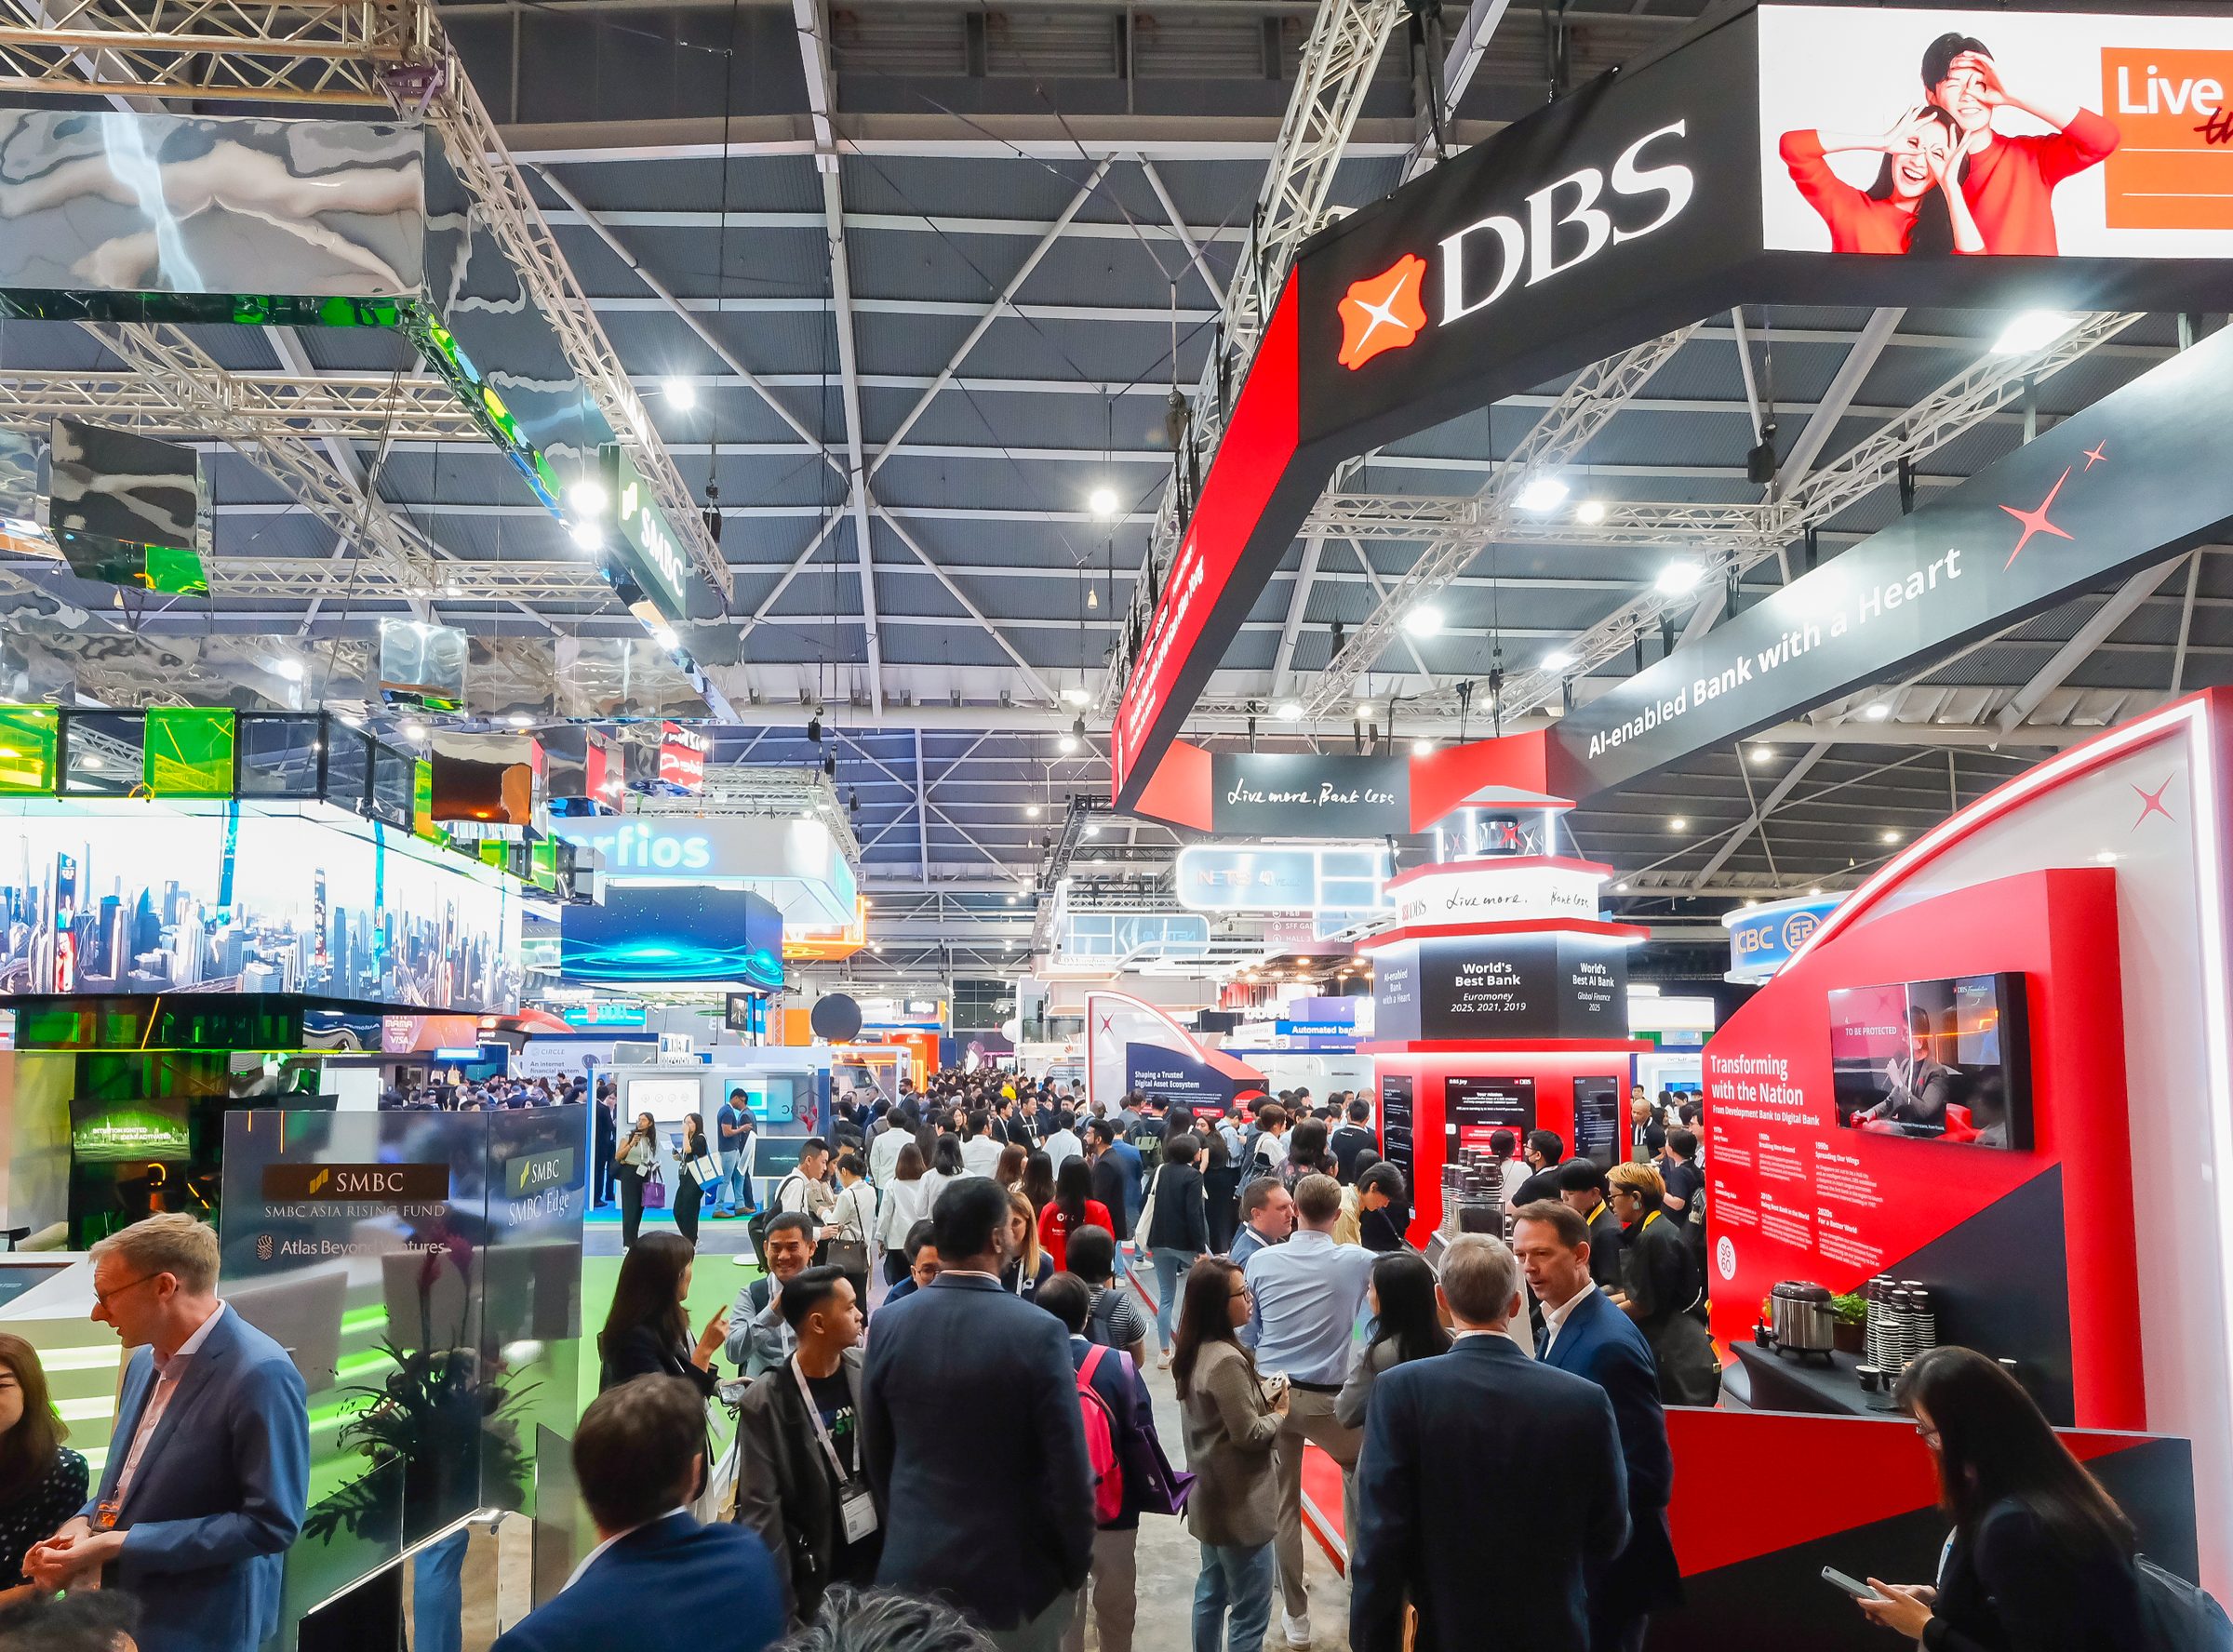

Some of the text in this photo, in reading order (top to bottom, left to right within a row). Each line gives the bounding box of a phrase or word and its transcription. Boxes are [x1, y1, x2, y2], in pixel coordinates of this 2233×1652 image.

[2118, 64, 2224, 115] Live
[1437, 118, 1694, 327] DBS
[640, 507, 684, 598] SMBC
[1588, 548, 1962, 760] AI-enabled Bank with a Heart
[1227, 778, 1266, 805] Live
[1319, 782, 1359, 806] Bank
[1365, 789, 1395, 805] less
[1197, 871, 1250, 886] NETS
[1446, 886, 1480, 910] Live
[1550, 886, 1571, 905] Bank
[1409, 899, 1427, 919] DBS
[1286, 935, 1305, 943] HALL
[1734, 926, 1774, 954] ICBC
[1462, 963, 1512, 974] World's
[1580, 963, 1606, 975] World's
[1389, 982, 1402, 993] Bank
[1455, 975, 1521, 987] Best Bank
[1572, 975, 1615, 988] Best AI Bank
[1383, 993, 1395, 1006] with
[1397, 993, 1411, 1005] Heart
[1464, 993, 1514, 1003] Euromoney
[1577, 992, 1611, 1002] Global Finance
[1451, 1002, 1527, 1013] 2025, 2021, 2019
[1588, 1004, 1601, 1012] 2025
[1291, 1026, 1337, 1034] Automated
[1854, 1027, 1863, 1035] BE
[1863, 1026, 1897, 1035] PROTECTED
[391, 1036, 408, 1045] VISA
[1711, 1054, 1788, 1081] Transforming
[1135, 1071, 1157, 1080] Shaping
[1161, 1071, 1183, 1079] Trusted
[1135, 1080, 1153, 1089] Digital
[1170, 1081, 1200, 1089] Ecosystem
[1712, 1080, 1804, 1106] with the Nation
[1713, 1105, 1821, 1126] From Development Bank to Digital Bank
[1815, 1141, 1829, 1151] 1990s
[1815, 1151, 1860, 1166] Spreading Our Wings
[532, 1159, 559, 1183] SMBC
[336, 1173, 404, 1192] SMBC
[264, 1206, 446, 1218] SMBC ASIA RISING FUND
[508, 1189, 569, 1227] SMBC Edge
[1818, 1217, 1826, 1226] For
[1829, 1219, 1844, 1231] Better
[1844, 1223, 1859, 1234] World
[280, 1240, 317, 1256] Atlas
[321, 1240, 373, 1258] Beyond
[1720, 1244, 1732, 1258] SG
[1720, 1257, 1732, 1273] 60
